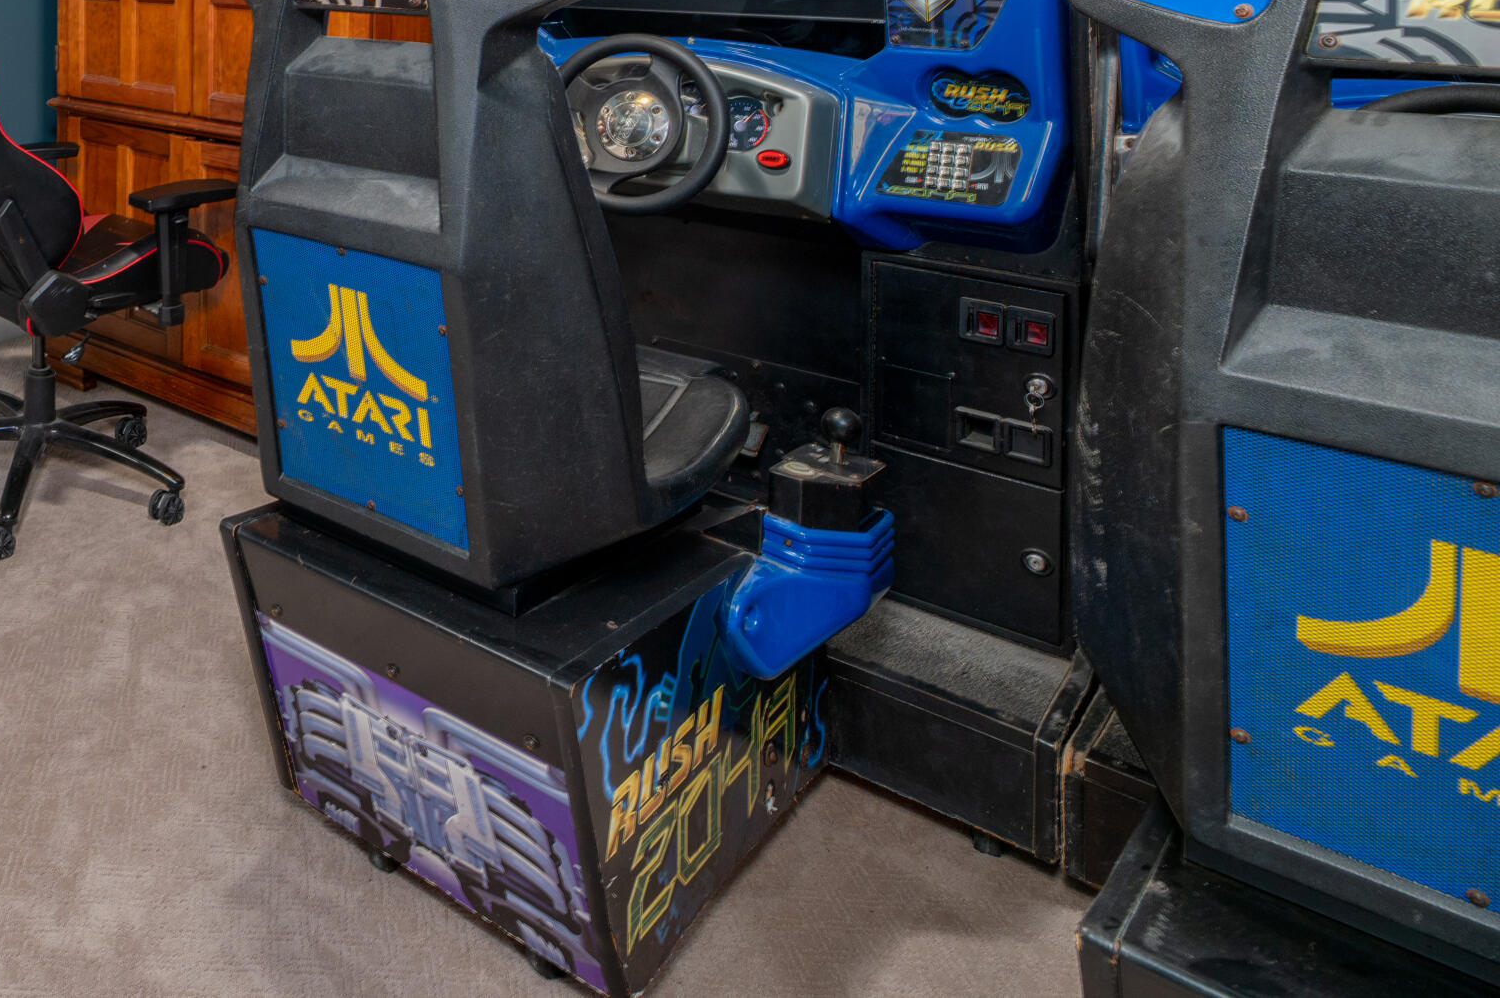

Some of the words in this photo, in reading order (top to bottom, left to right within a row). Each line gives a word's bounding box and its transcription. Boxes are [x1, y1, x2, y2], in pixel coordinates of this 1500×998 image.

[943, 83, 1010, 102] RUSH
[297, 371, 433, 449] ATARI
[297, 408, 436, 467] GAMES
[604, 683, 726, 864] RUSH
